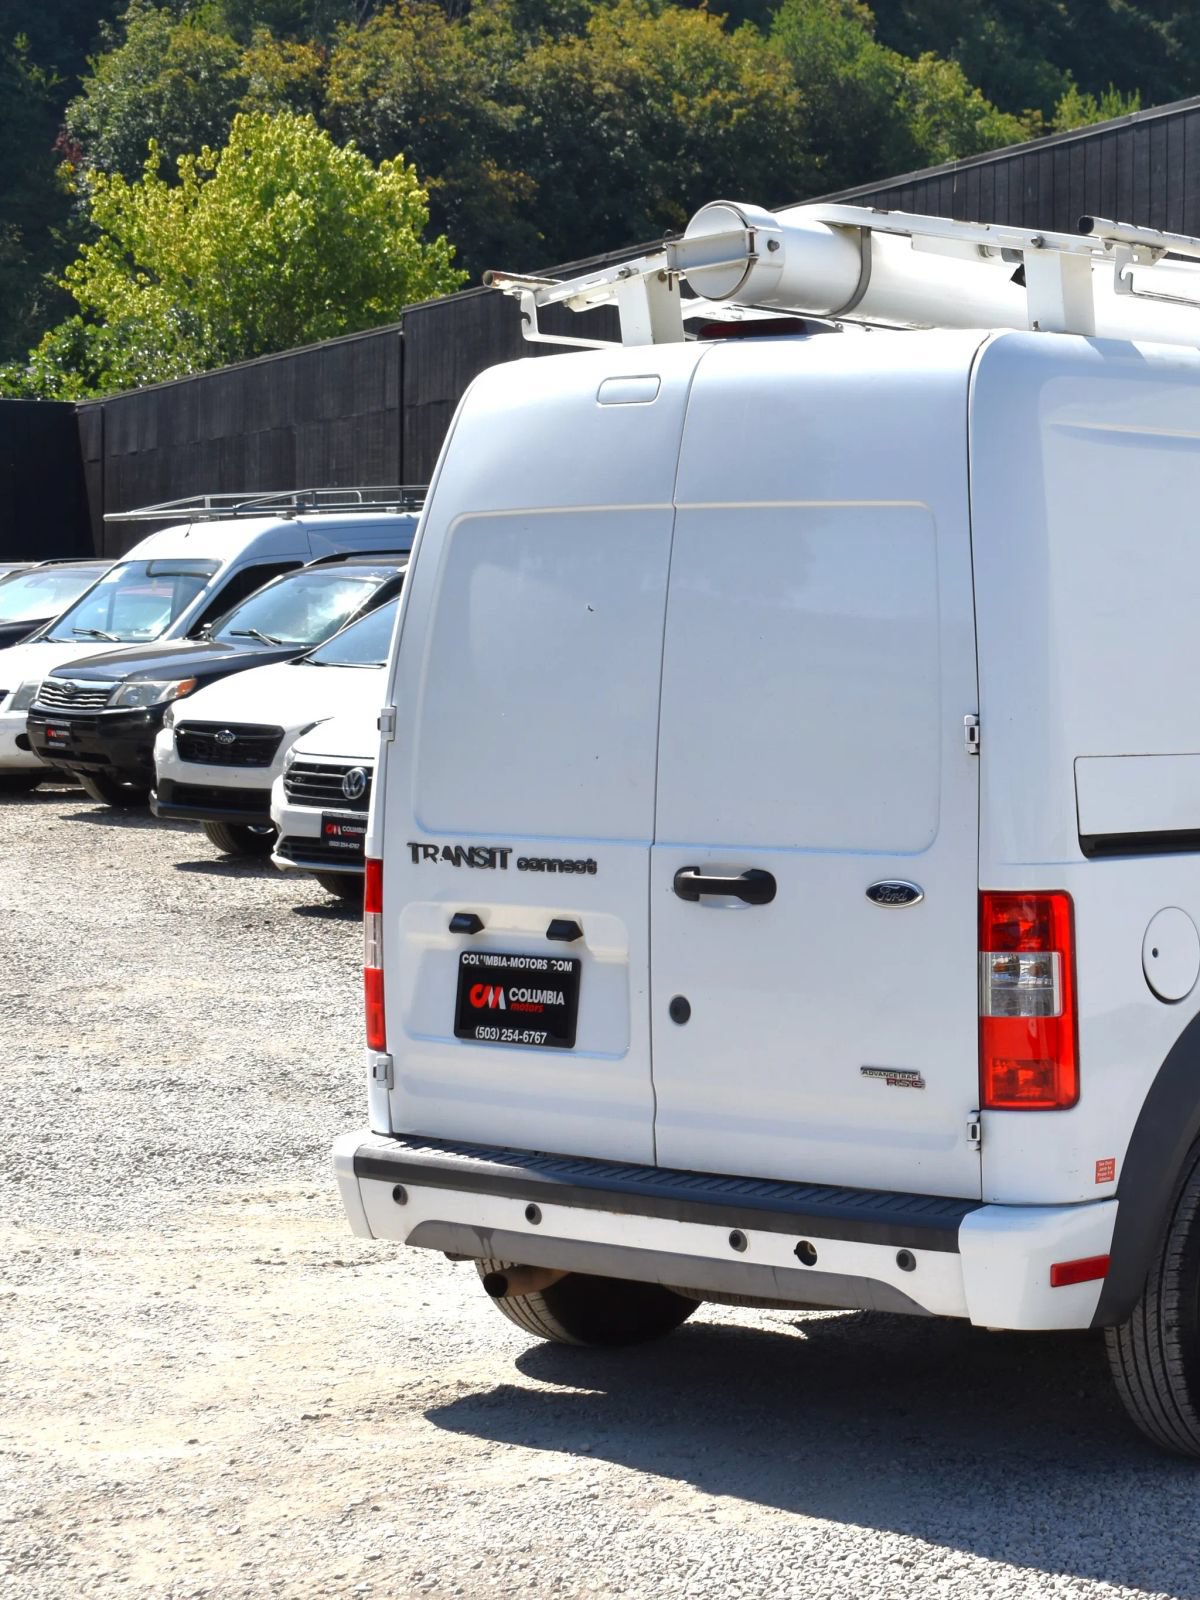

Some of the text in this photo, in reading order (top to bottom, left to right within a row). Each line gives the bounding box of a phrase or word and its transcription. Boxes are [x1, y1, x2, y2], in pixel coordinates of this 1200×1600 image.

[407, 842, 598, 875] TRANSIT connect
[508, 987, 565, 1006] COLUMBIA
[510, 1002, 545, 1014] motors
[475, 1026, 548, 1045] (503) 254-6767
[886, 1077, 926, 1089] RSC
